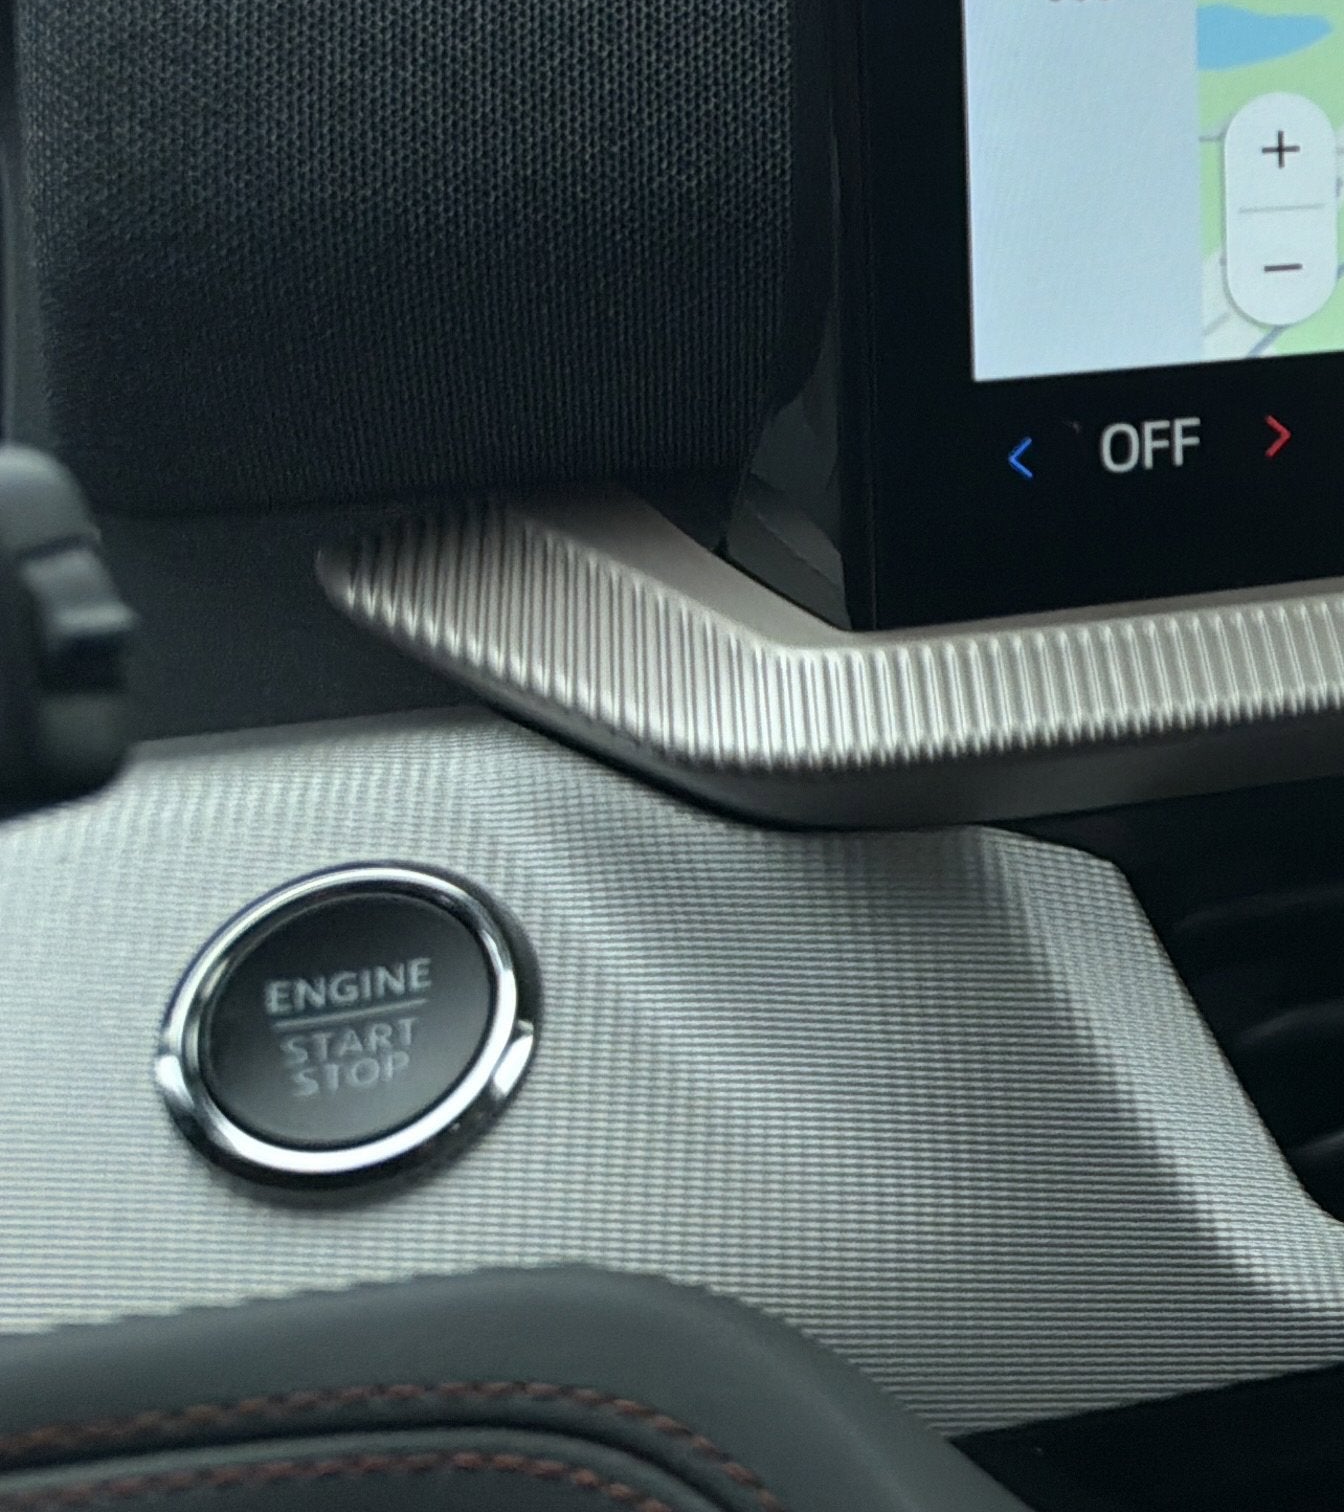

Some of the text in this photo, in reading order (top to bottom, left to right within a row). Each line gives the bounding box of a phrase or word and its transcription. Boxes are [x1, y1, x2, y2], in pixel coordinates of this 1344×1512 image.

[1101, 417, 1201, 473] OFF
[265, 957, 432, 1015] ENGINE
[280, 1017, 417, 1065] START
[291, 1050, 410, 1097] STOP
